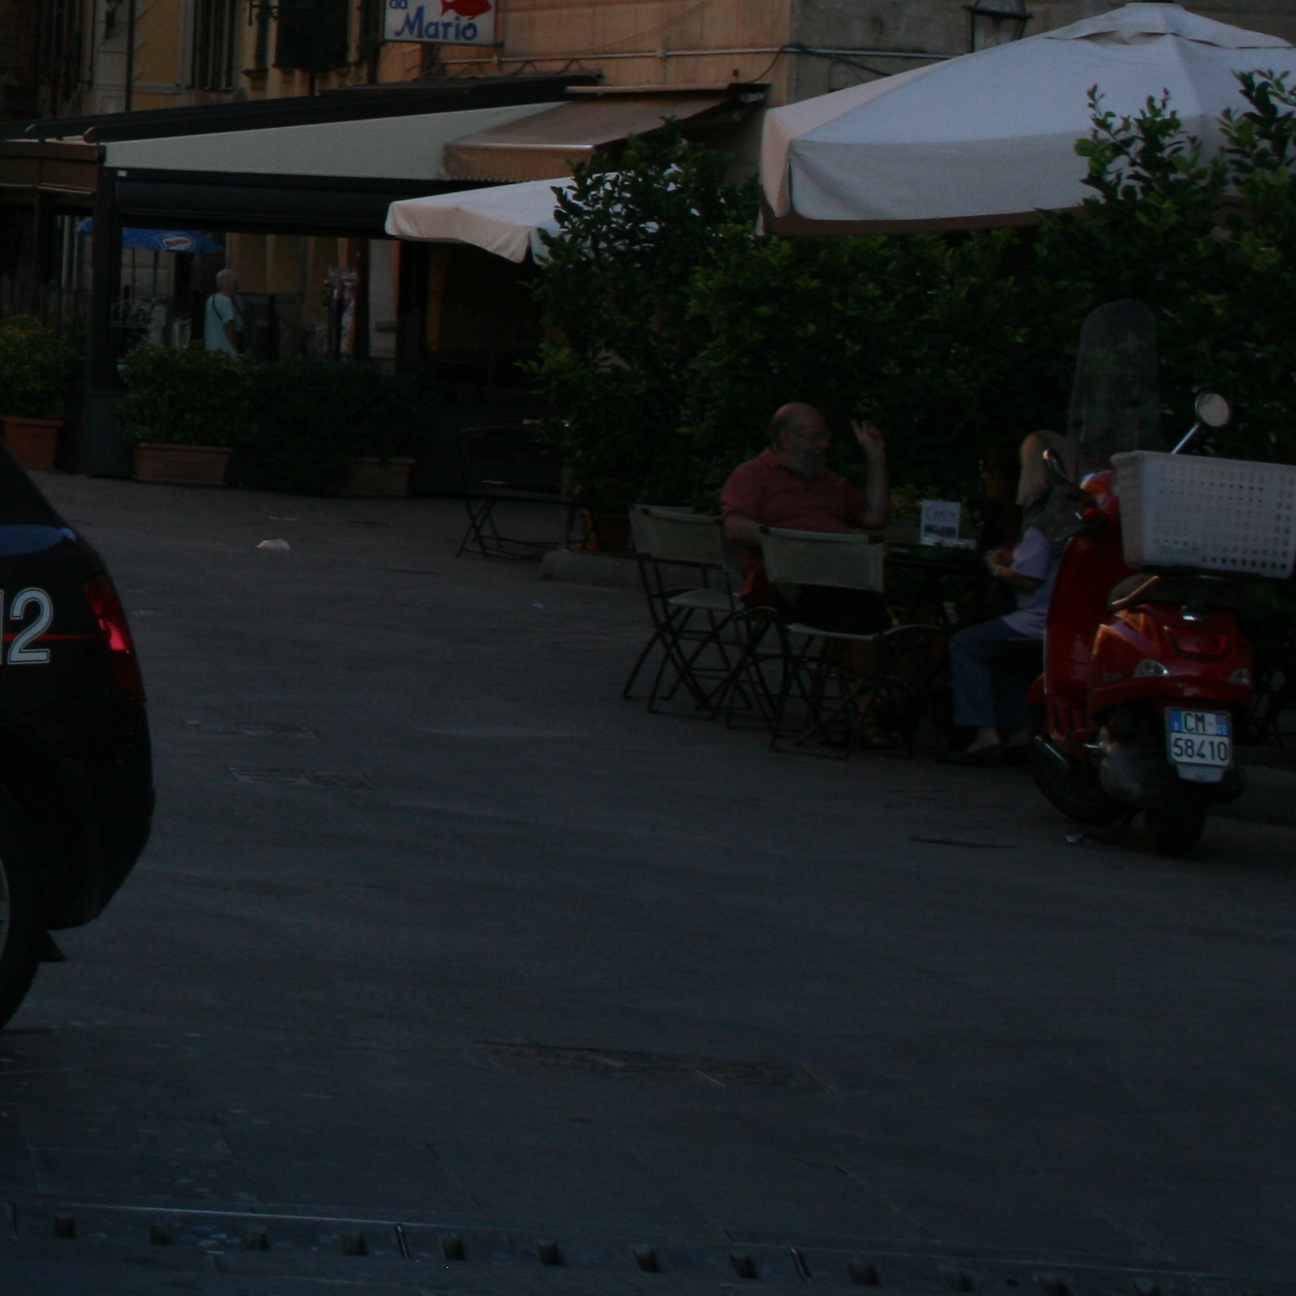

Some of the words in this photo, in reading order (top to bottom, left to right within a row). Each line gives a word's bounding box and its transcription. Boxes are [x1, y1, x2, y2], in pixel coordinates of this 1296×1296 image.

[394, 6, 477, 41] Mario
[1183, 712, 1206, 733] CM
[1174, 737, 1228, 762] 58410
